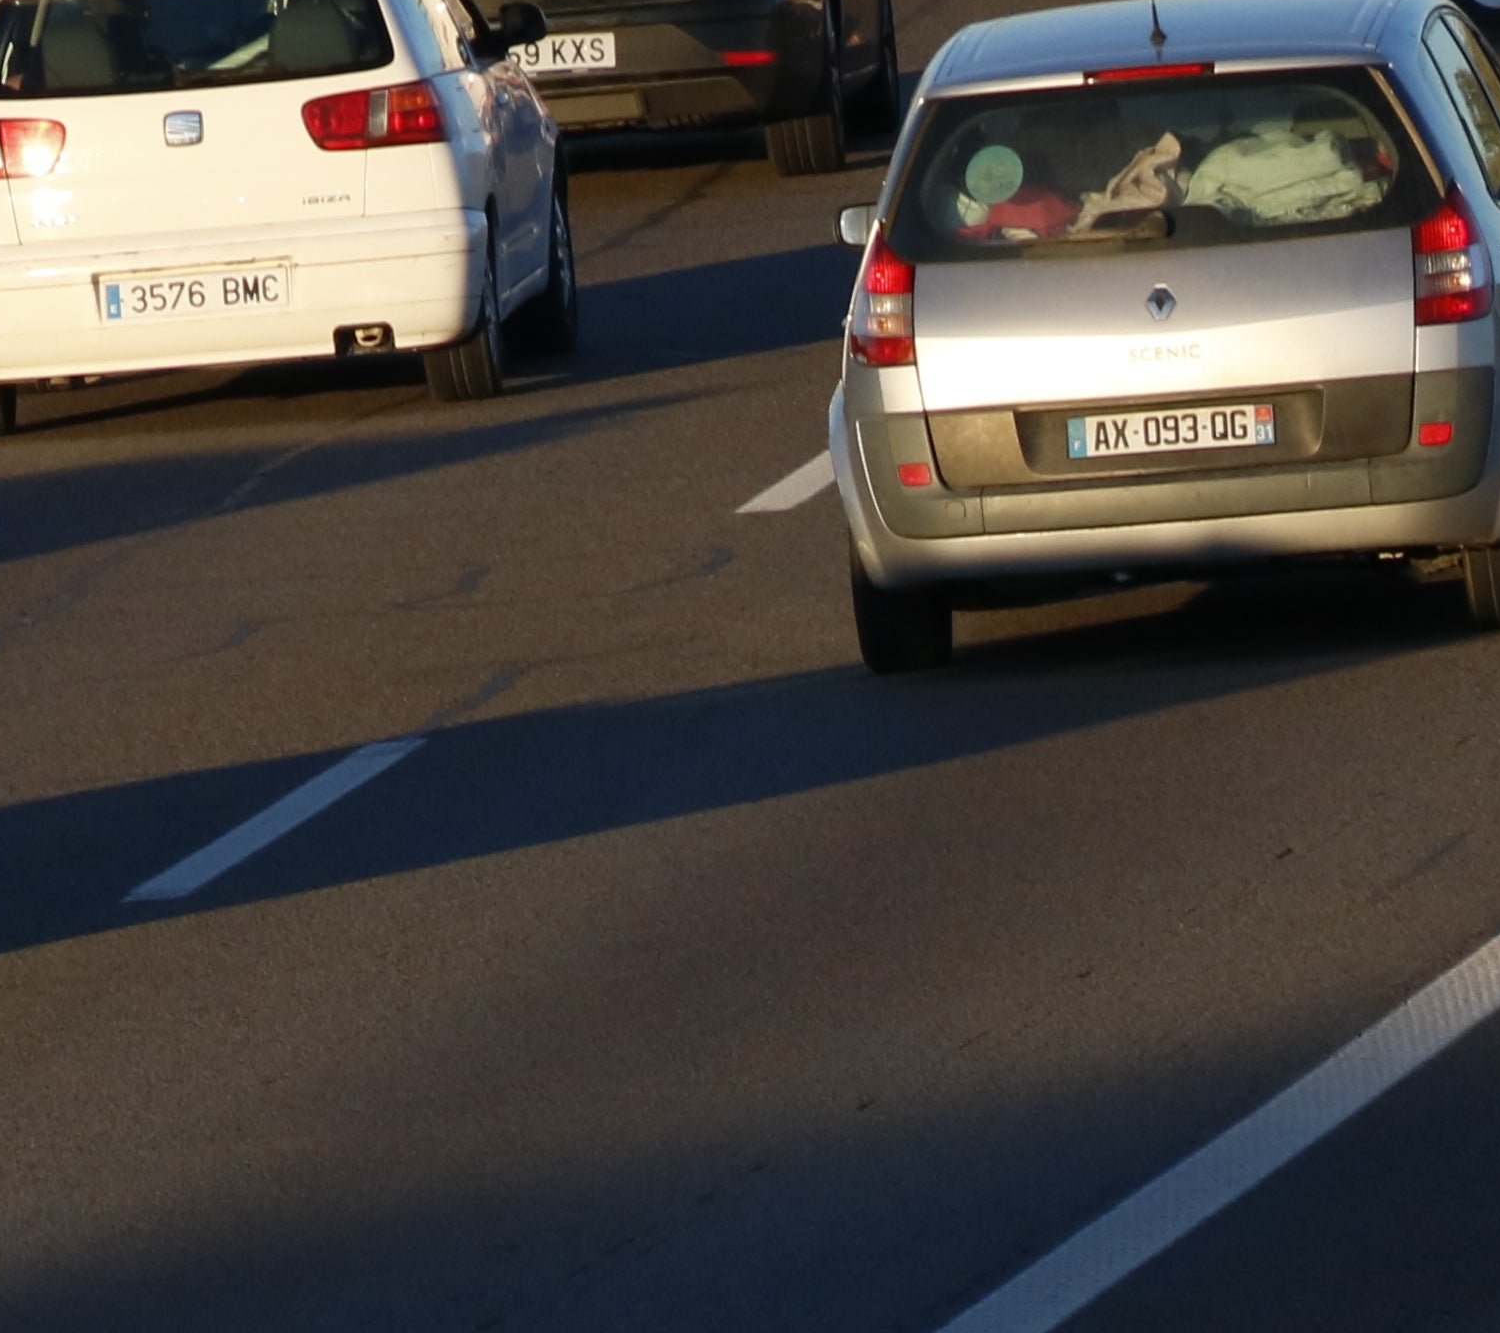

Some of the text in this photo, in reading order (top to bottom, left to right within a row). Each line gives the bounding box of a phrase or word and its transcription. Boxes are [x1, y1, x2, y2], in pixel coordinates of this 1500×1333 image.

[551, 37, 605, 64] KXS
[131, 281, 206, 313] 3576
[222, 275, 280, 306] BMC
[1128, 343, 1201, 362] SCENIC
[1255, 423, 1273, 441] 31
